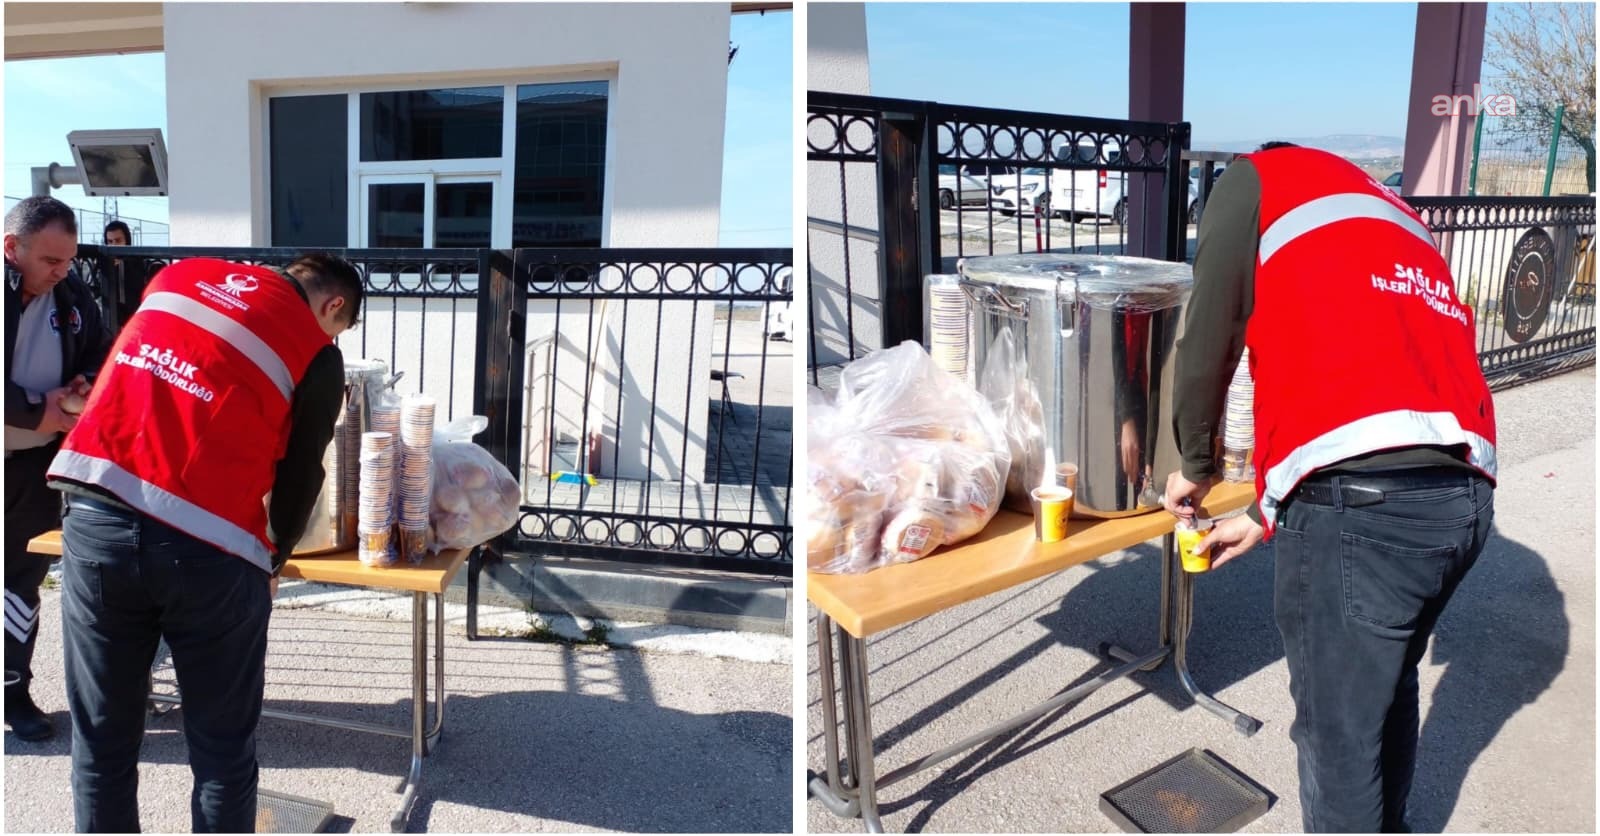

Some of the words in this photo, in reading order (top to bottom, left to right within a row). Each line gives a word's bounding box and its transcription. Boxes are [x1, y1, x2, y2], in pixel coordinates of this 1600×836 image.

[1394, 264, 1451, 302] SAĞLIK
[139, 343, 199, 380] SAĞLIK
[144, 361, 214, 402] MÜDÜRLÜĞÜ
